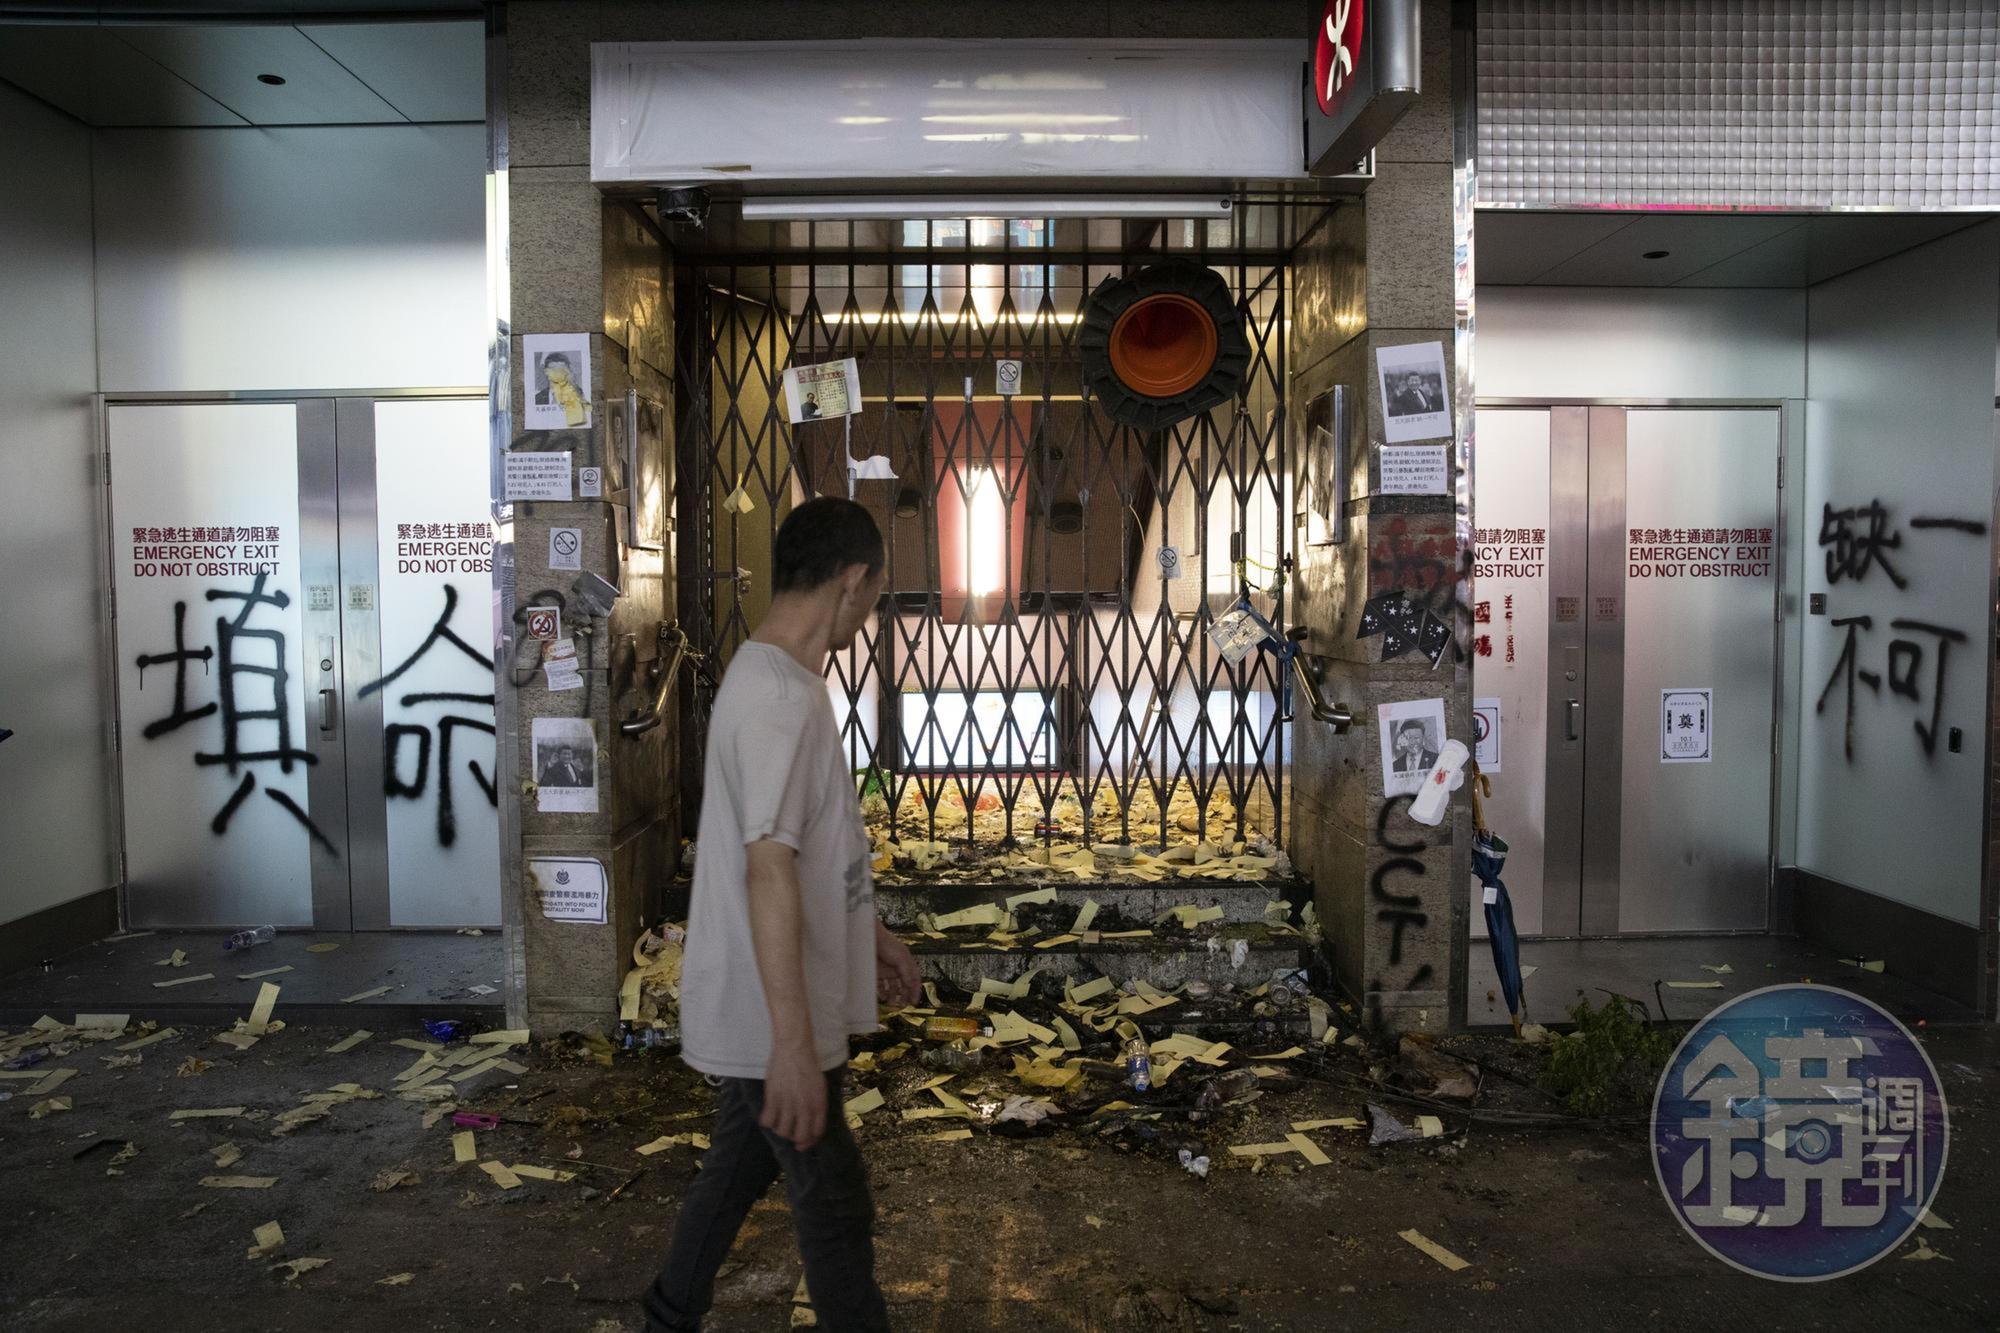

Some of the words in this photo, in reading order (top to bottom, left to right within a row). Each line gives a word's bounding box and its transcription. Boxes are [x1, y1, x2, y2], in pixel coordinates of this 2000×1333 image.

[133, 527, 280, 543] 緊急逃生通道請勿阻塞
[1474, 528, 1546, 544] 道請勿阻塞
[1629, 528, 1772, 544] 緊急逃生通道請勿阻塞
[133, 546, 237, 560] EMERGENCY
[243, 545, 280, 559] EXIT
[398, 541, 492, 557] EMERGENC
[1819, 500, 1987, 590] 缺一
[1509, 547, 1545, 561] EXIT
[1629, 547, 1730, 561] EMERGENCY
[1736, 547, 1772, 560] EXIT
[134, 563, 157, 577] DO
[160, 563, 193, 577] NOT
[196, 562, 280, 576] OBSTRUCT
[398, 560, 421, 574] DO
[425, 559, 457, 573] NOT
[460, 559, 493, 573] OBS
[1474, 564, 1545, 578] BSTRUCT
[1629, 564, 1651, 577] DO
[1655, 564, 1687, 577] NOT
[1690, 563, 1771, 577] OBSTRUCT
[1817, 615, 1968, 764] 不可
